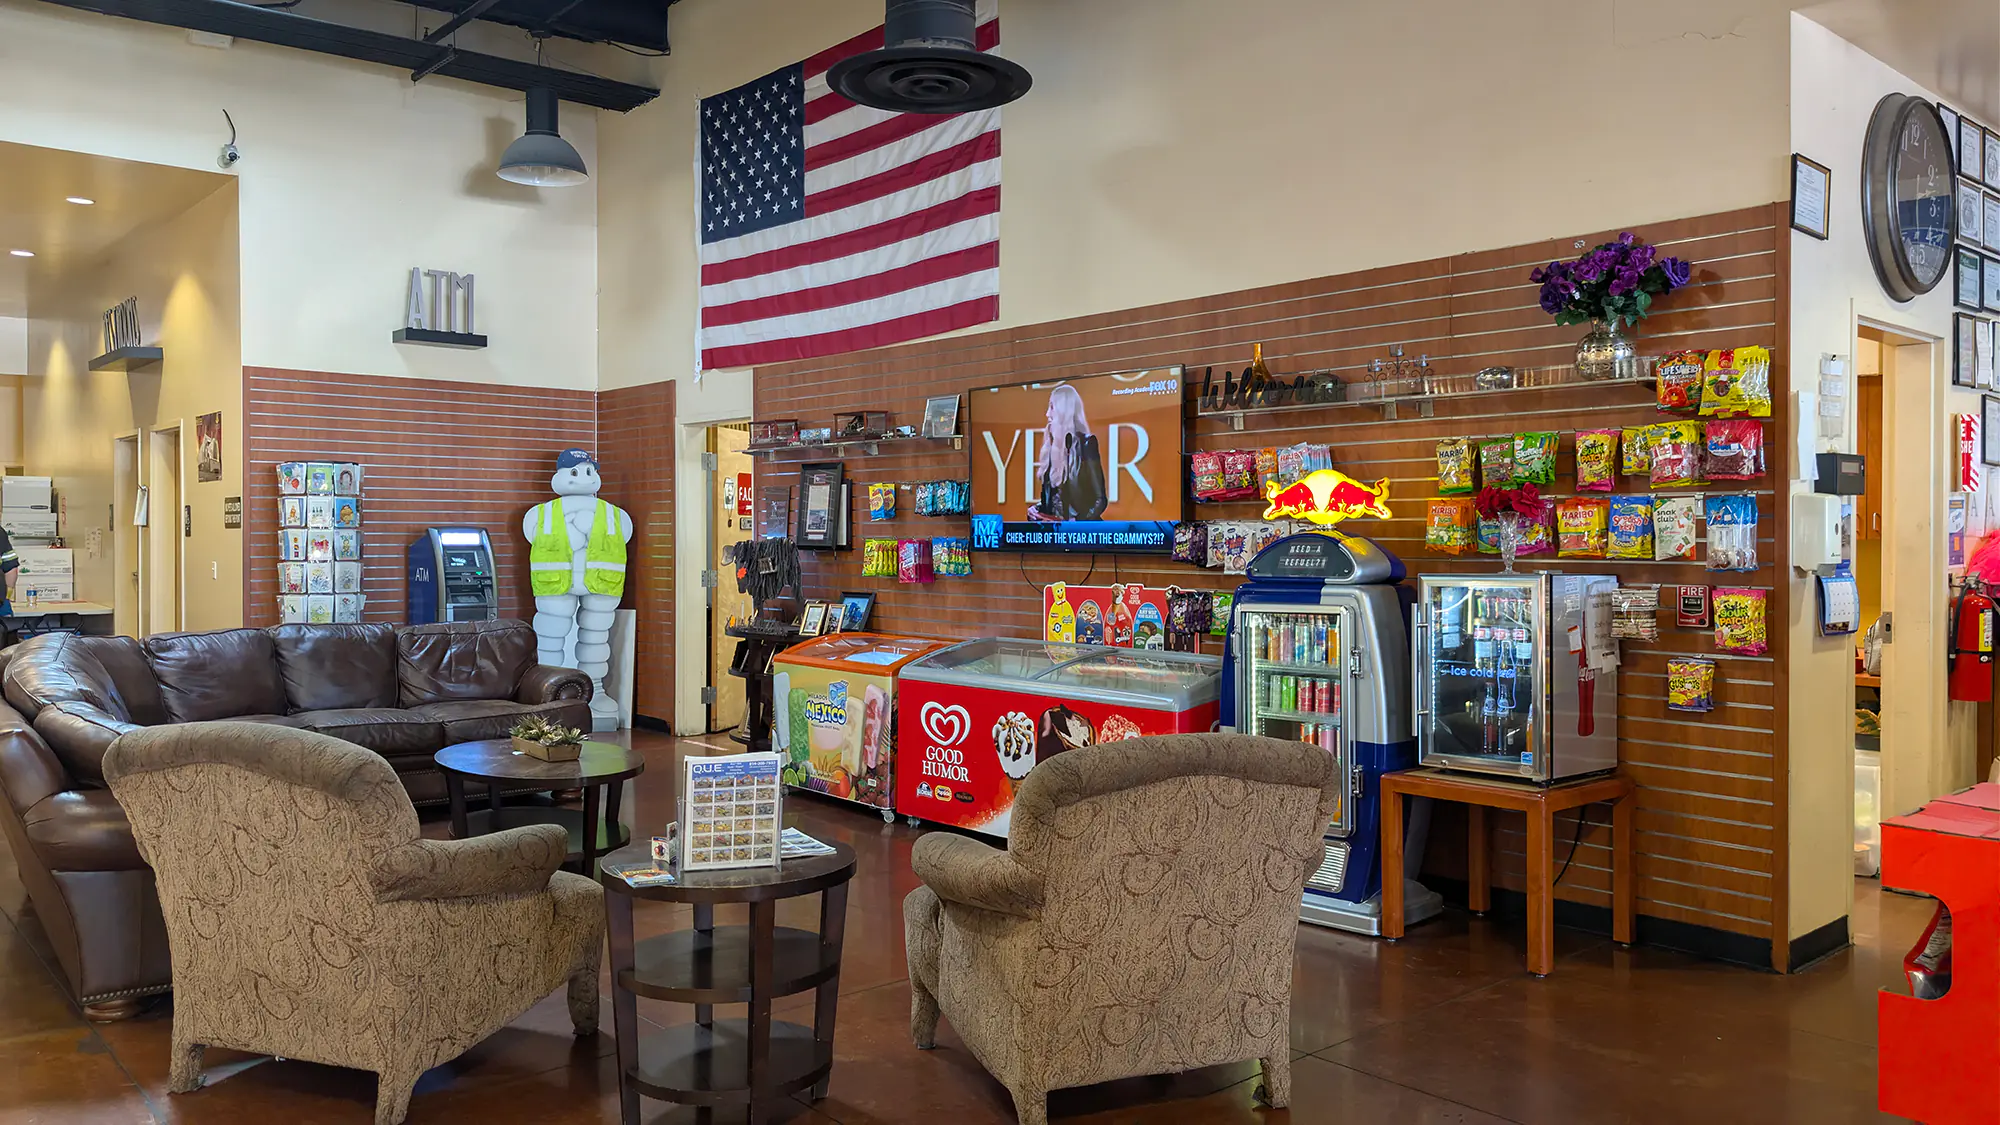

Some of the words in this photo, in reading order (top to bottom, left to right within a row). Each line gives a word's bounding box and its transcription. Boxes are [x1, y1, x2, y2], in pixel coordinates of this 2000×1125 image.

[1910, 124, 1920, 147] 12
[1928, 164, 1936, 187] 2
[407, 266, 475, 335] ATM
[1149, 381, 1166, 392] FOX
[1167, 379, 1177, 390] 10
[1581, 445, 1604, 456] SOUR
[982, 423, 1153, 504] YER
[1561, 509, 1594, 520] HARIBO
[1025, 533, 1043, 544] FLUB
[1043, 532, 1052, 544] OF
[1053, 533, 1067, 544] THE
[1067, 532, 1087, 544] YEAR
[1087, 532, 1098, 544] AT
[1098, 532, 1113, 544] THE
[1113, 532, 1165, 545] GRAMMYS?!?
[1290, 545, 1311, 553] NEED
[415, 567, 430, 583] ATM
[1680, 586, 1705, 597] FIRE
[1719, 608, 1749, 618] SOUR
[1719, 616, 1749, 627] PATCH
[1450, 665, 1468, 676] ice
[1469, 667, 1495, 678] cold
[805, 700, 847, 725] MEXICO
[926, 745, 964, 765] GOOD
[693, 764, 725, 775] Q.U.E.
[922, 759, 970, 783] HUMOR
